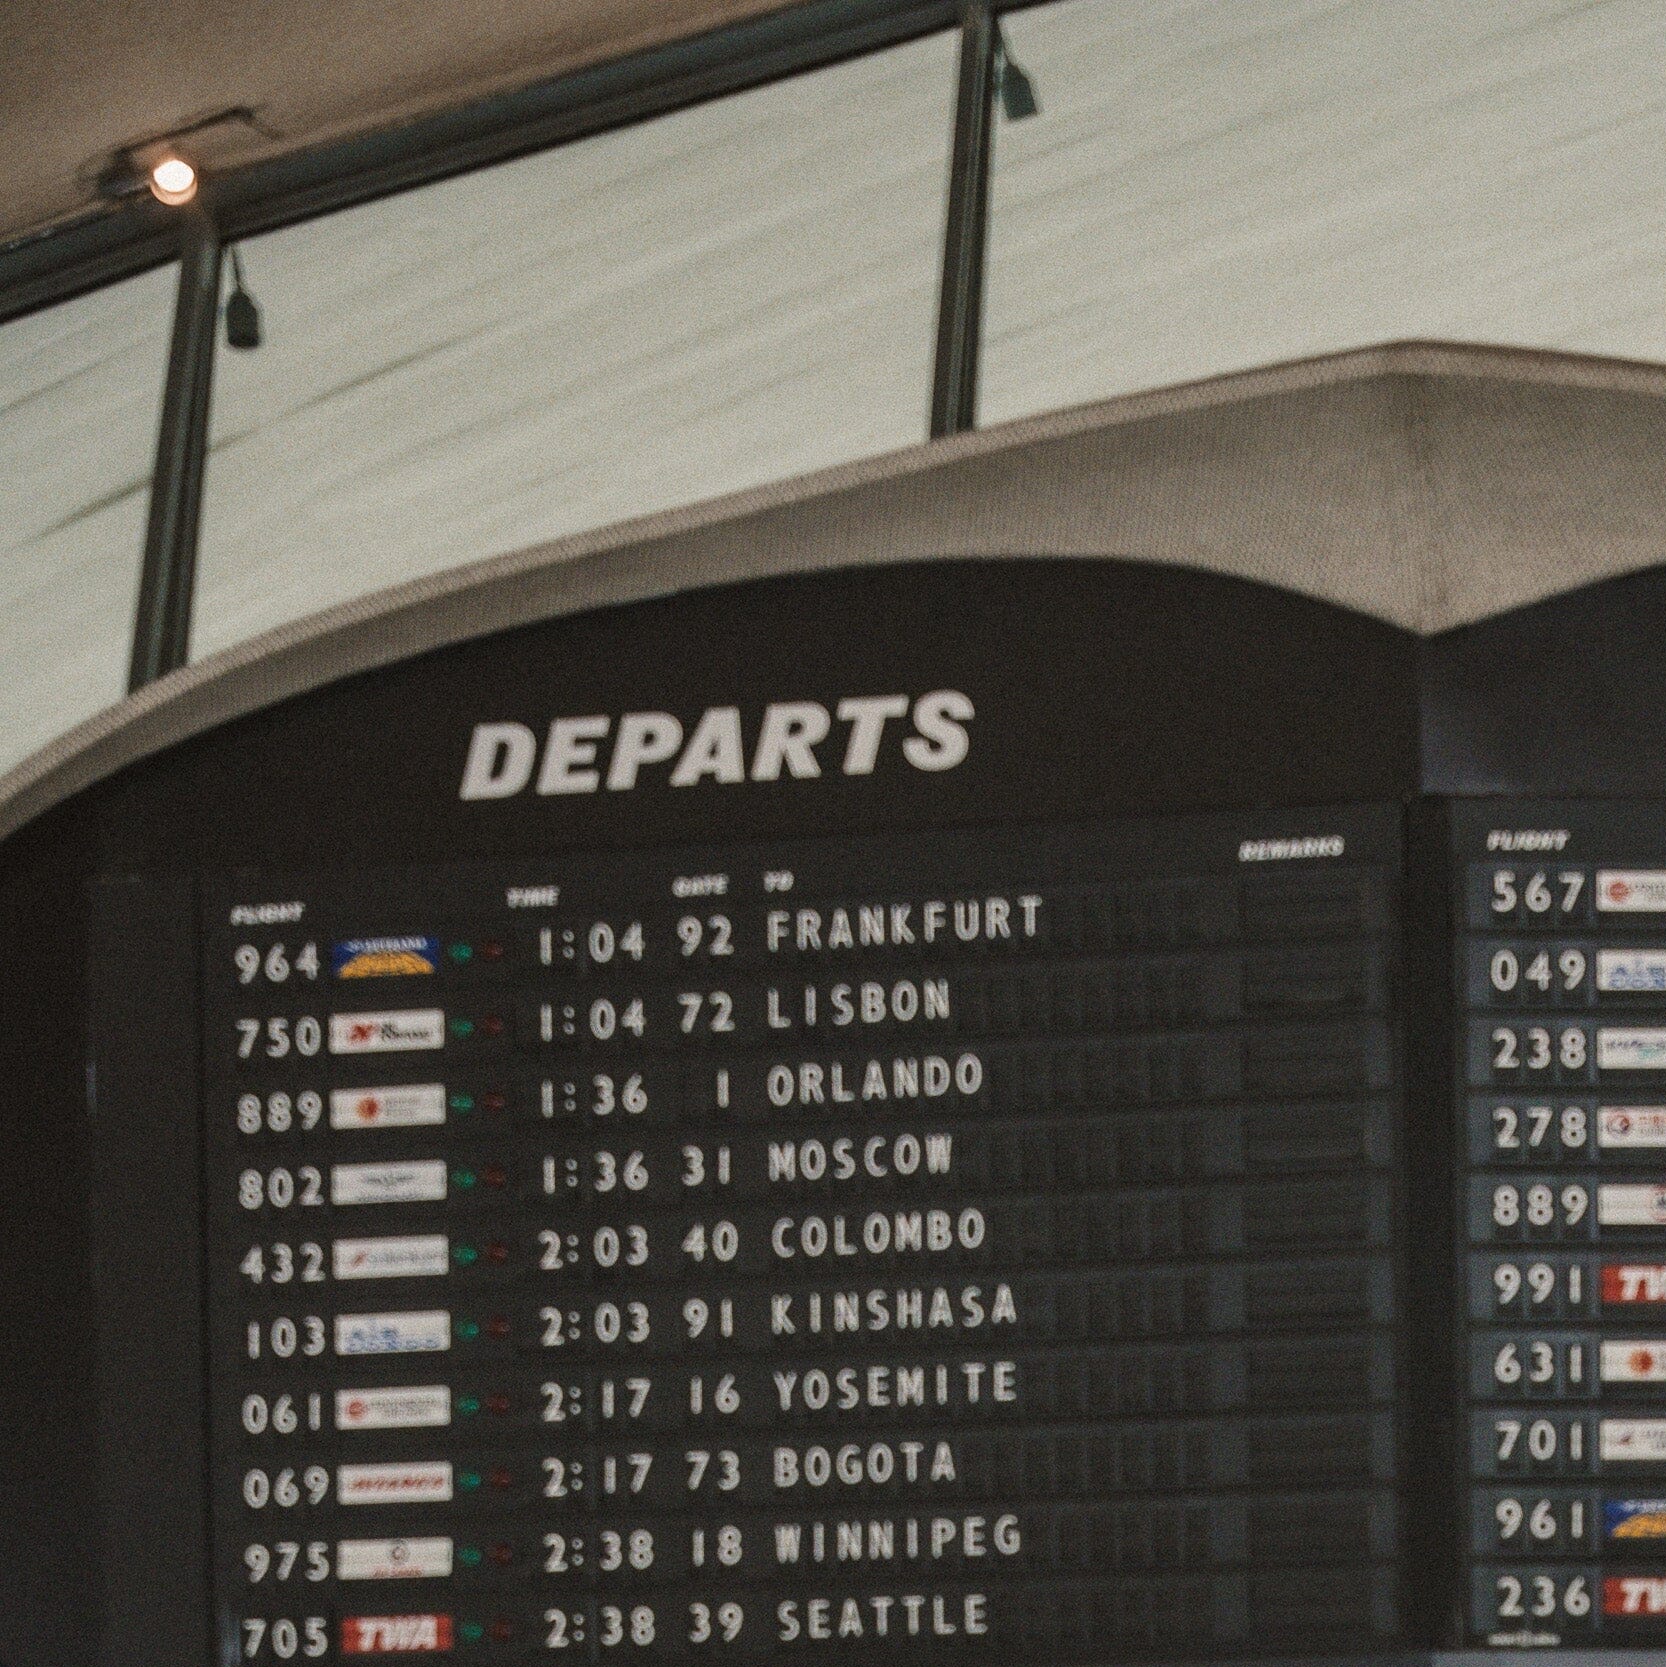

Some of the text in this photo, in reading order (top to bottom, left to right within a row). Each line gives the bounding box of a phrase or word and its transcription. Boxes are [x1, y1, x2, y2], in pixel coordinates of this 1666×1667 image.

[460, 690, 975, 801] DEPARTS
[1486, 829, 1570, 851] FLIGHT
[1491, 869, 1585, 913] 567
[235, 944, 319, 984] 964
[539, 922, 645, 964] 1:04
[677, 915, 734, 956] 92
[767, 895, 1042, 951] FRANKFURT
[1489, 948, 1587, 992] 049
[237, 980, 950, 1058] 750 1:04 72 LISBON
[1492, 1025, 1587, 1070] 238
[238, 1053, 983, 1134] 889 1:36 1 ORLANDO
[1492, 1104, 1588, 1149] 278
[239, 1133, 953, 1210] 802 1:36 31 MOSCOW
[1492, 1181, 1589, 1227] 889
[241, 1242, 325, 1284] 432
[539, 1225, 649, 1270] 2:03
[682, 1220, 739, 1262] 40
[771, 1207, 986, 1259] COLOMBO
[1493, 1261, 1582, 1305] 991
[248, 1283, 1017, 1359] 103 2:03 91 KINSHASA
[1493, 1340, 1583, 1384] 631
[242, 1394, 321, 1435] 061
[541, 1377, 651, 1423] 2:17
[690, 1374, 741, 1414] 16
[773, 1361, 1017, 1411] YOSEMITE
[1494, 1418, 1583, 1461] 701
[243, 1441, 956, 1509] 069 2:17 73 BOGOTA
[1495, 1497, 1584, 1540] 961
[244, 1514, 1021, 1583] 975 2:38 18 WINNIPEG
[1497, 1574, 1591, 1617] 236
[245, 1594, 987, 1659] 705 2:38 39 SEATTLE
[355, 1616, 439, 1651] TWA
